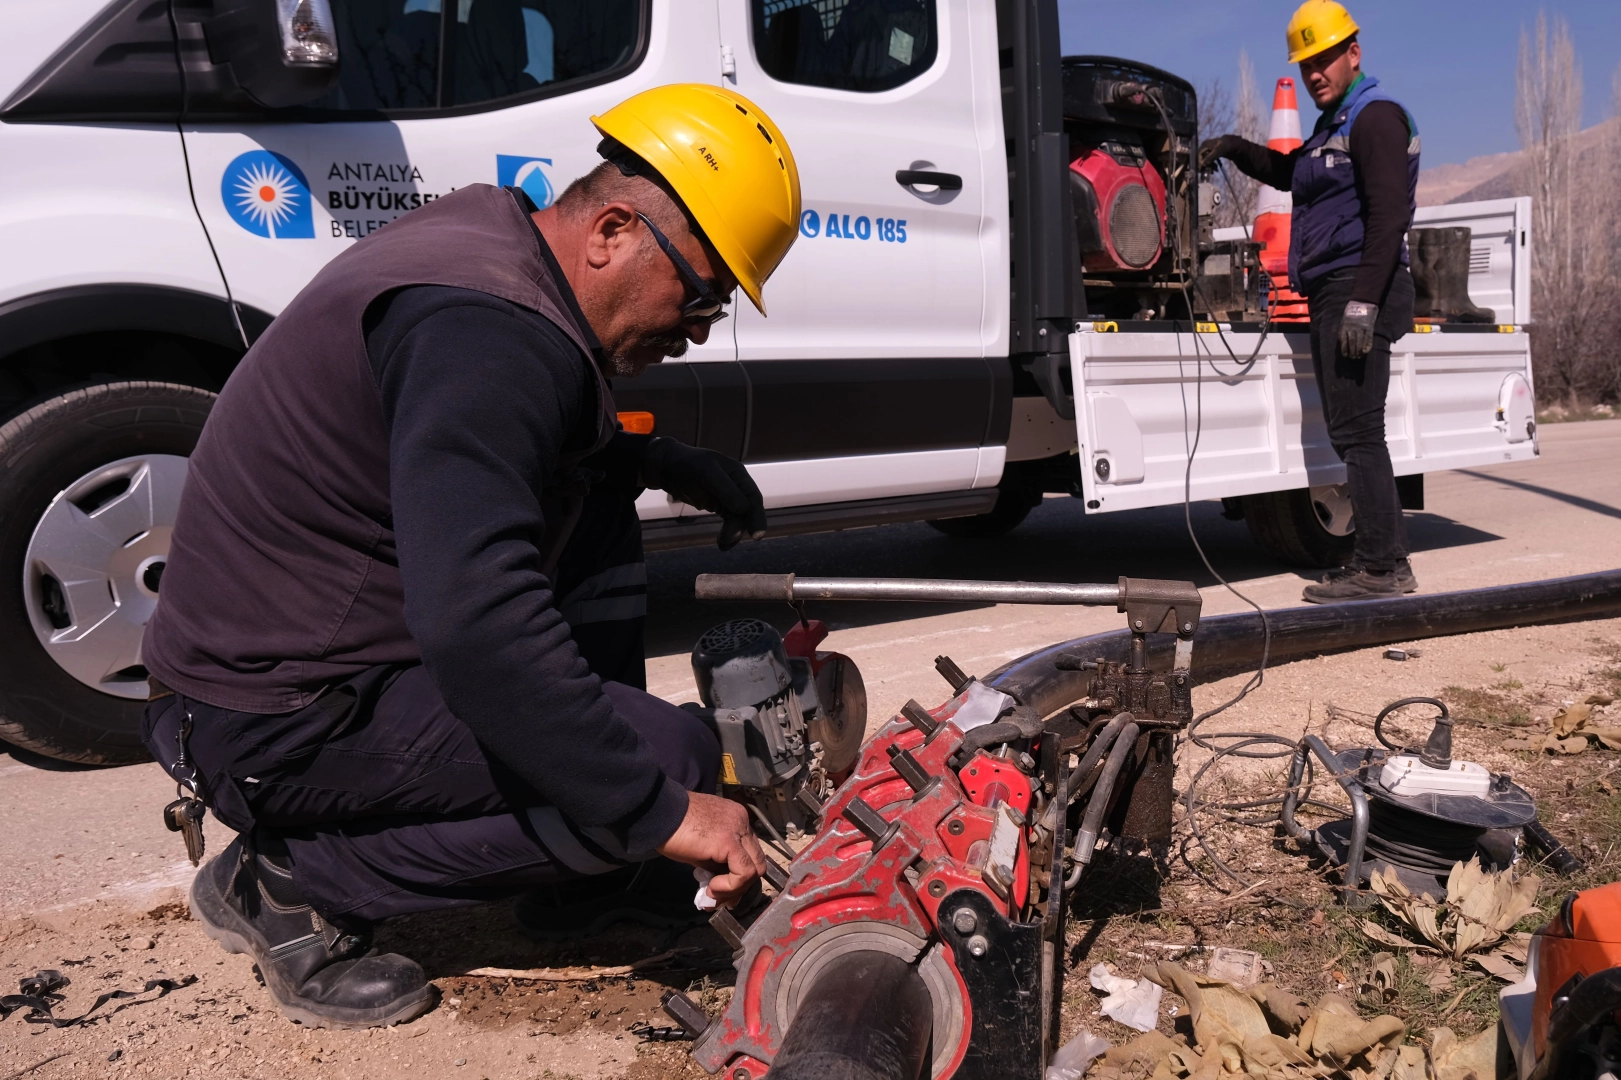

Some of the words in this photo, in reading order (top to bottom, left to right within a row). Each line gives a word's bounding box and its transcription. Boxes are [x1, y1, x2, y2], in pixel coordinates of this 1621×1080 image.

[697, 147, 707, 155] A
[704, 153, 719, 172] RH+
[327, 162, 425, 183] ANTALYA
[331, 215, 398, 238] BELE
[825, 213, 872, 241] ALO
[875, 217, 908, 244] 185
